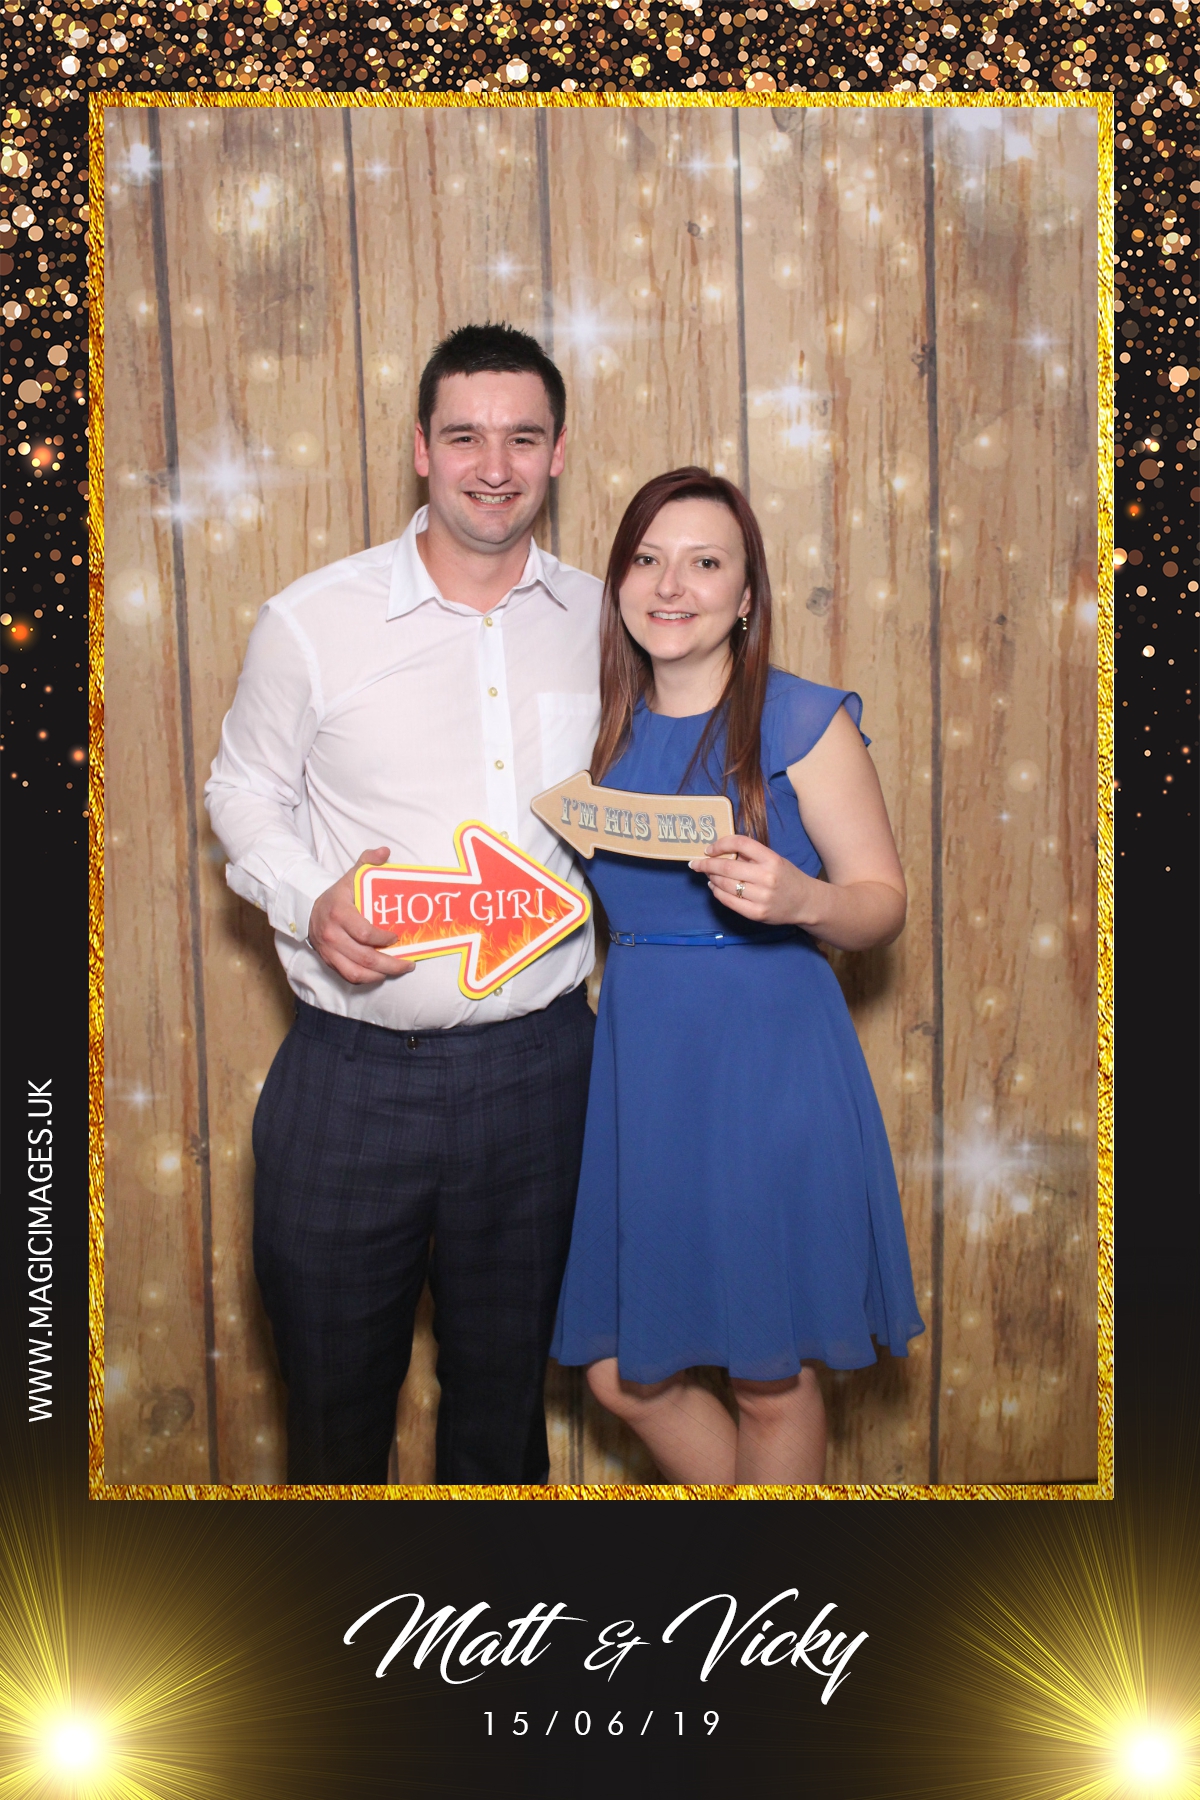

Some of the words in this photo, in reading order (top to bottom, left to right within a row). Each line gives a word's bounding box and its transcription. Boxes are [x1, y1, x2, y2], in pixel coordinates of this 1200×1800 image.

[560, 796, 599, 829] I'M
[602, 805, 651, 838] HIS
[654, 812, 718, 844] MRS
[374, 891, 461, 926] HOT
[469, 887, 558, 927] GIRL
